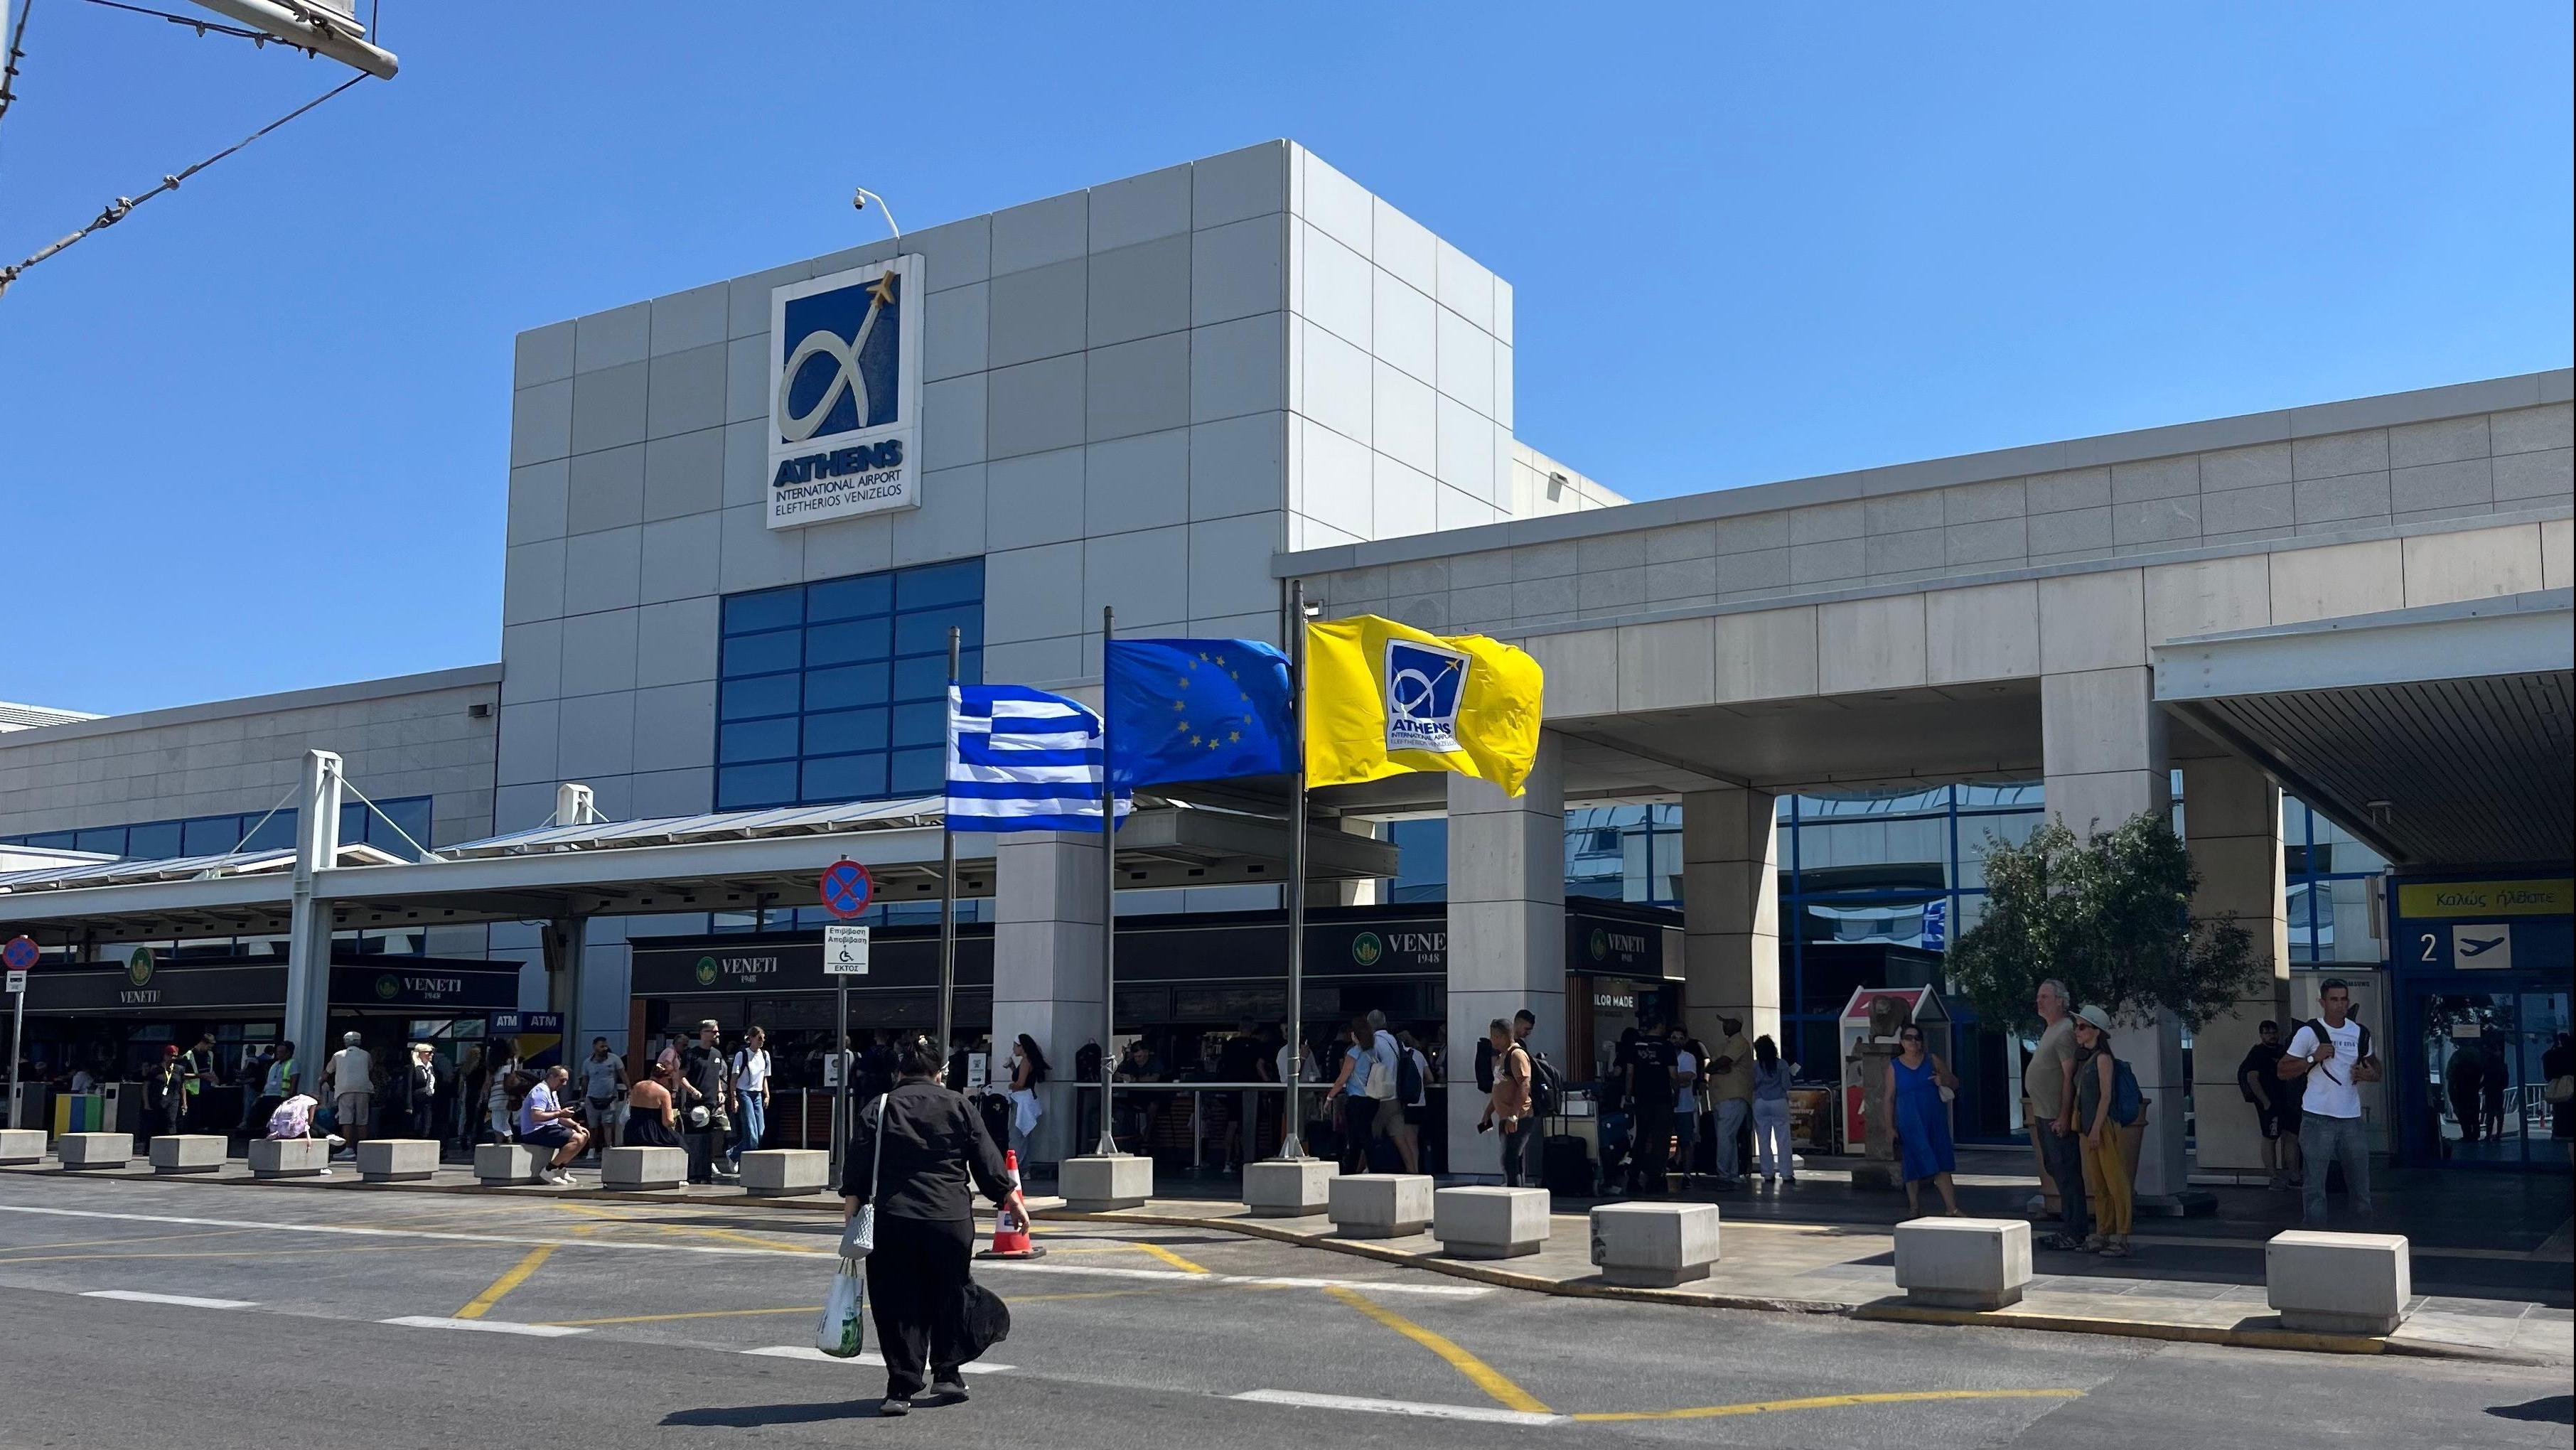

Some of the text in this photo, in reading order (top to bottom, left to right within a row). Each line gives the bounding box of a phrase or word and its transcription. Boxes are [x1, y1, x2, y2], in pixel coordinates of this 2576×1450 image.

[773, 439, 903, 487] ATHENS
[776, 469, 902, 503] INTERNATIONAL AIRPORT
[776, 484, 902, 516] ELEFTHERIOS VENIZELOS
[1392, 719, 1451, 734] ATHENS
[2436, 888, 2557, 908] Καλώς ήλθατε
[1388, 933, 1447, 952] VENE
[1608, 933, 1646, 953] VENETI
[2420, 933, 2437, 962] 2
[721, 957, 778, 974] VENETI
[1417, 953, 1439, 964] 1948
[404, 977, 461, 992] VENETI
[120, 989, 158, 1003] VENETI
[1594, 994, 1633, 1008] ILOR MADE
[497, 1016, 557, 1027] ATM ATM
